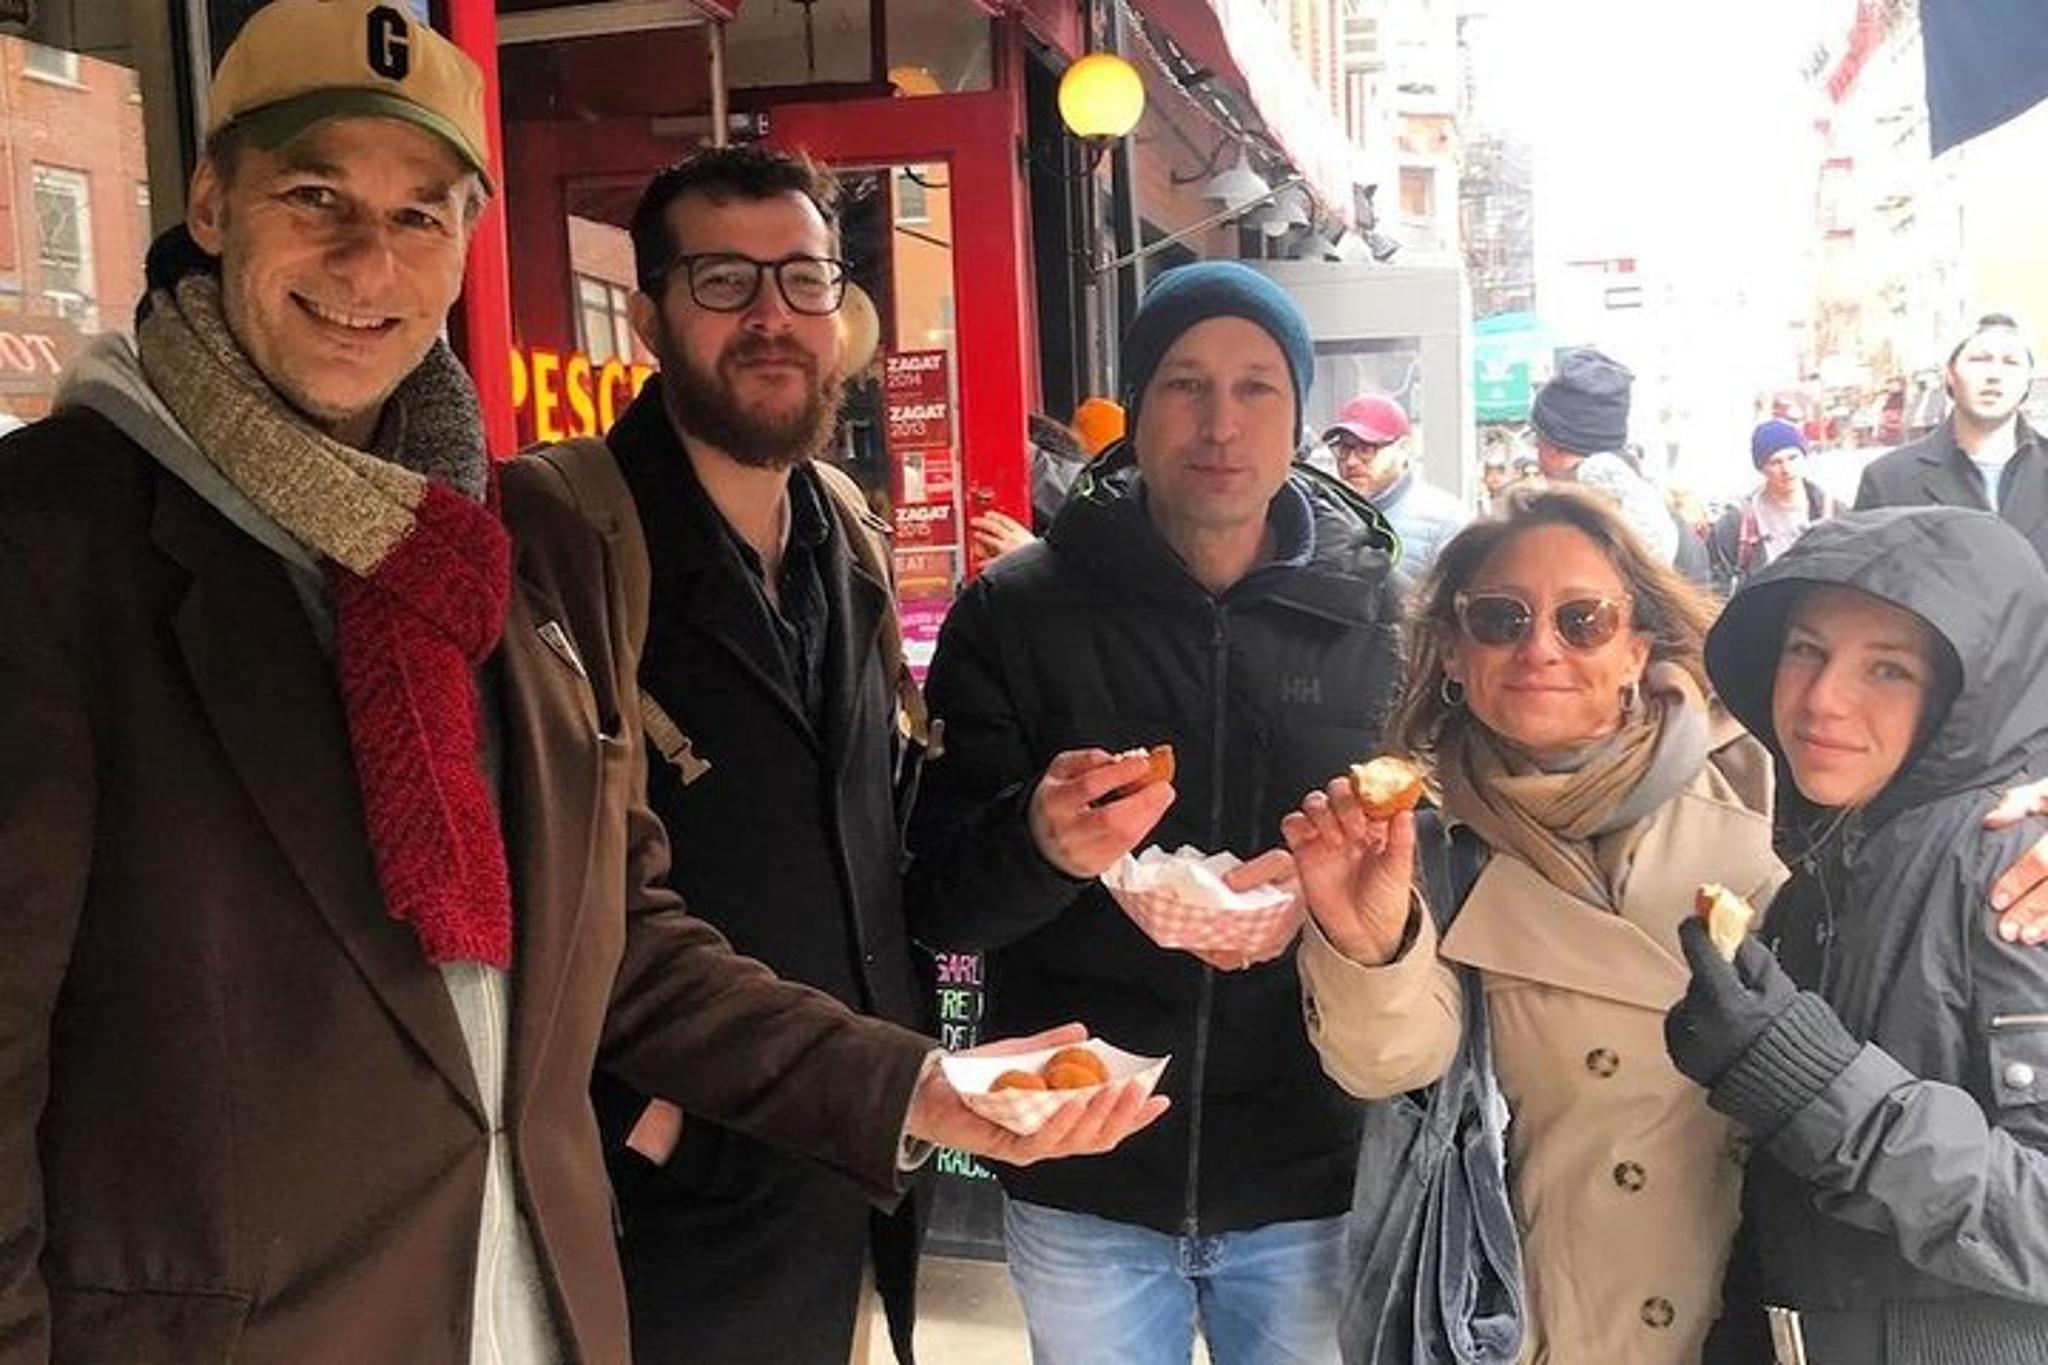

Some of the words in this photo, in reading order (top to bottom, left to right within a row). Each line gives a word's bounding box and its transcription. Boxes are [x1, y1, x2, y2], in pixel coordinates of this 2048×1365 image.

[366, 5, 410, 82] G
[887, 355, 942, 371] ZAGAT
[510, 348, 654, 444] ESC
[889, 403, 946, 421] ZAGAT
[895, 506, 950, 522] ZAGAT
